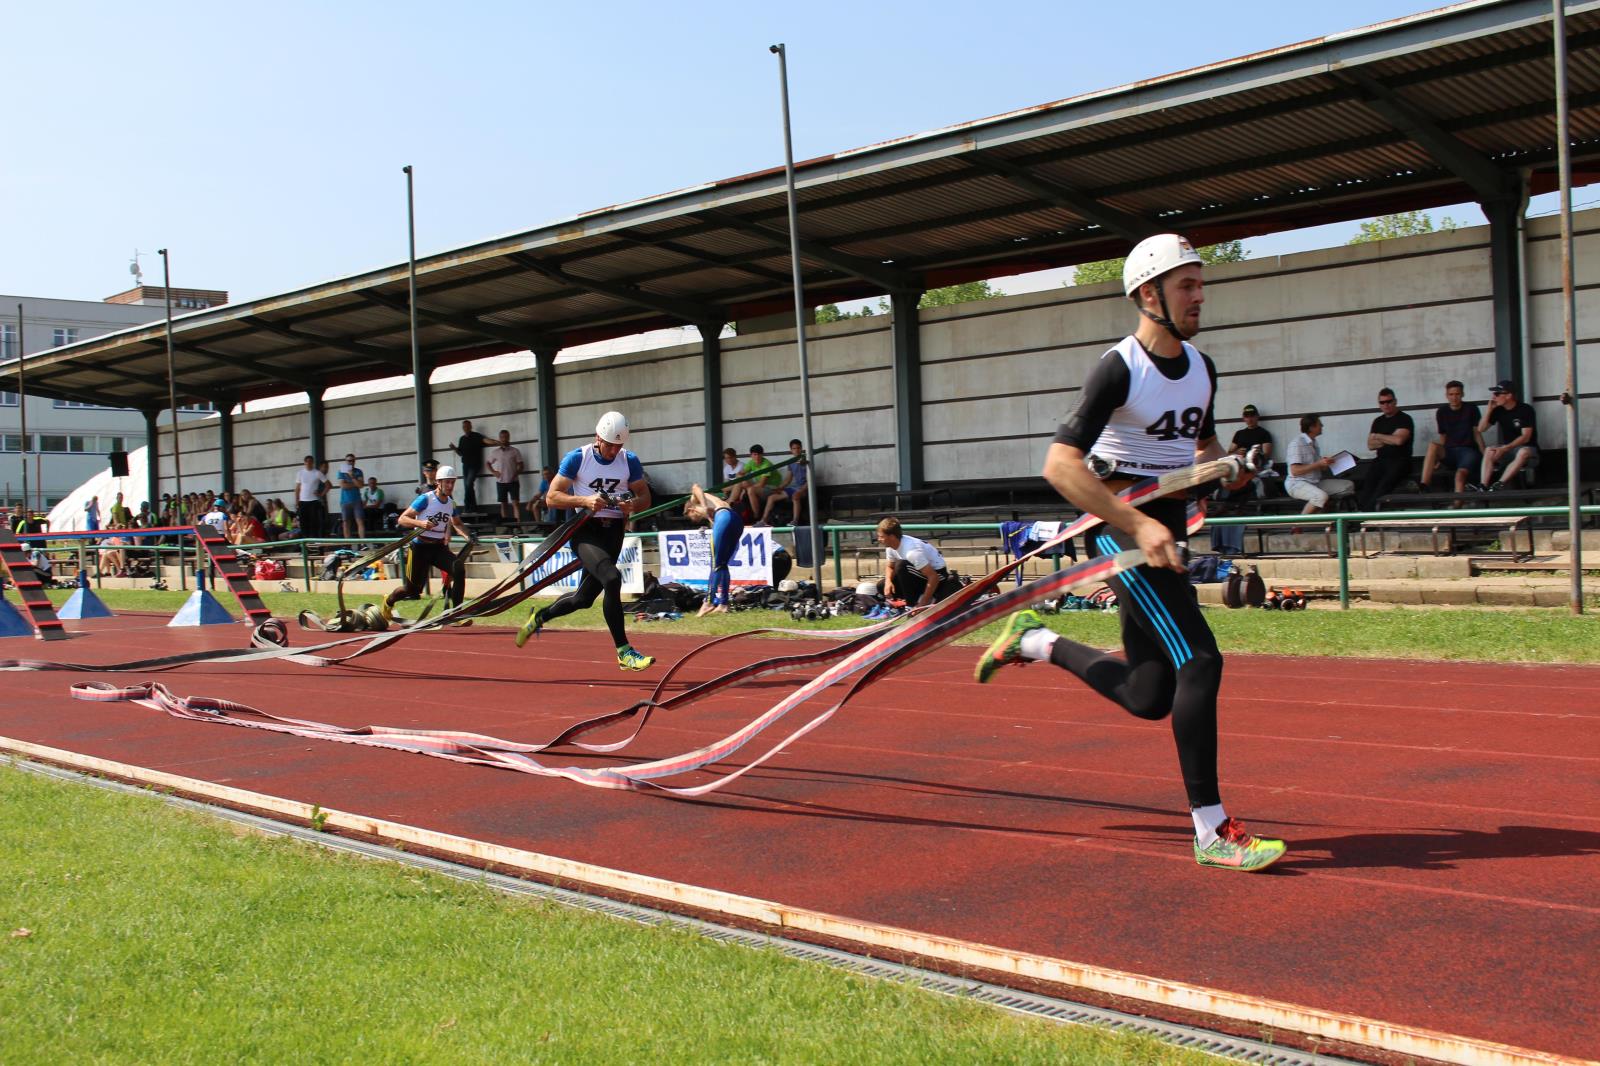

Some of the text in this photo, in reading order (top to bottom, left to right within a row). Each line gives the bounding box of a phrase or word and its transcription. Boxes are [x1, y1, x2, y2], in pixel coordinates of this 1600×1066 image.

[1145, 406, 1203, 441] 48
[588, 477, 621, 493] 47
[434, 511, 450, 523] 46
